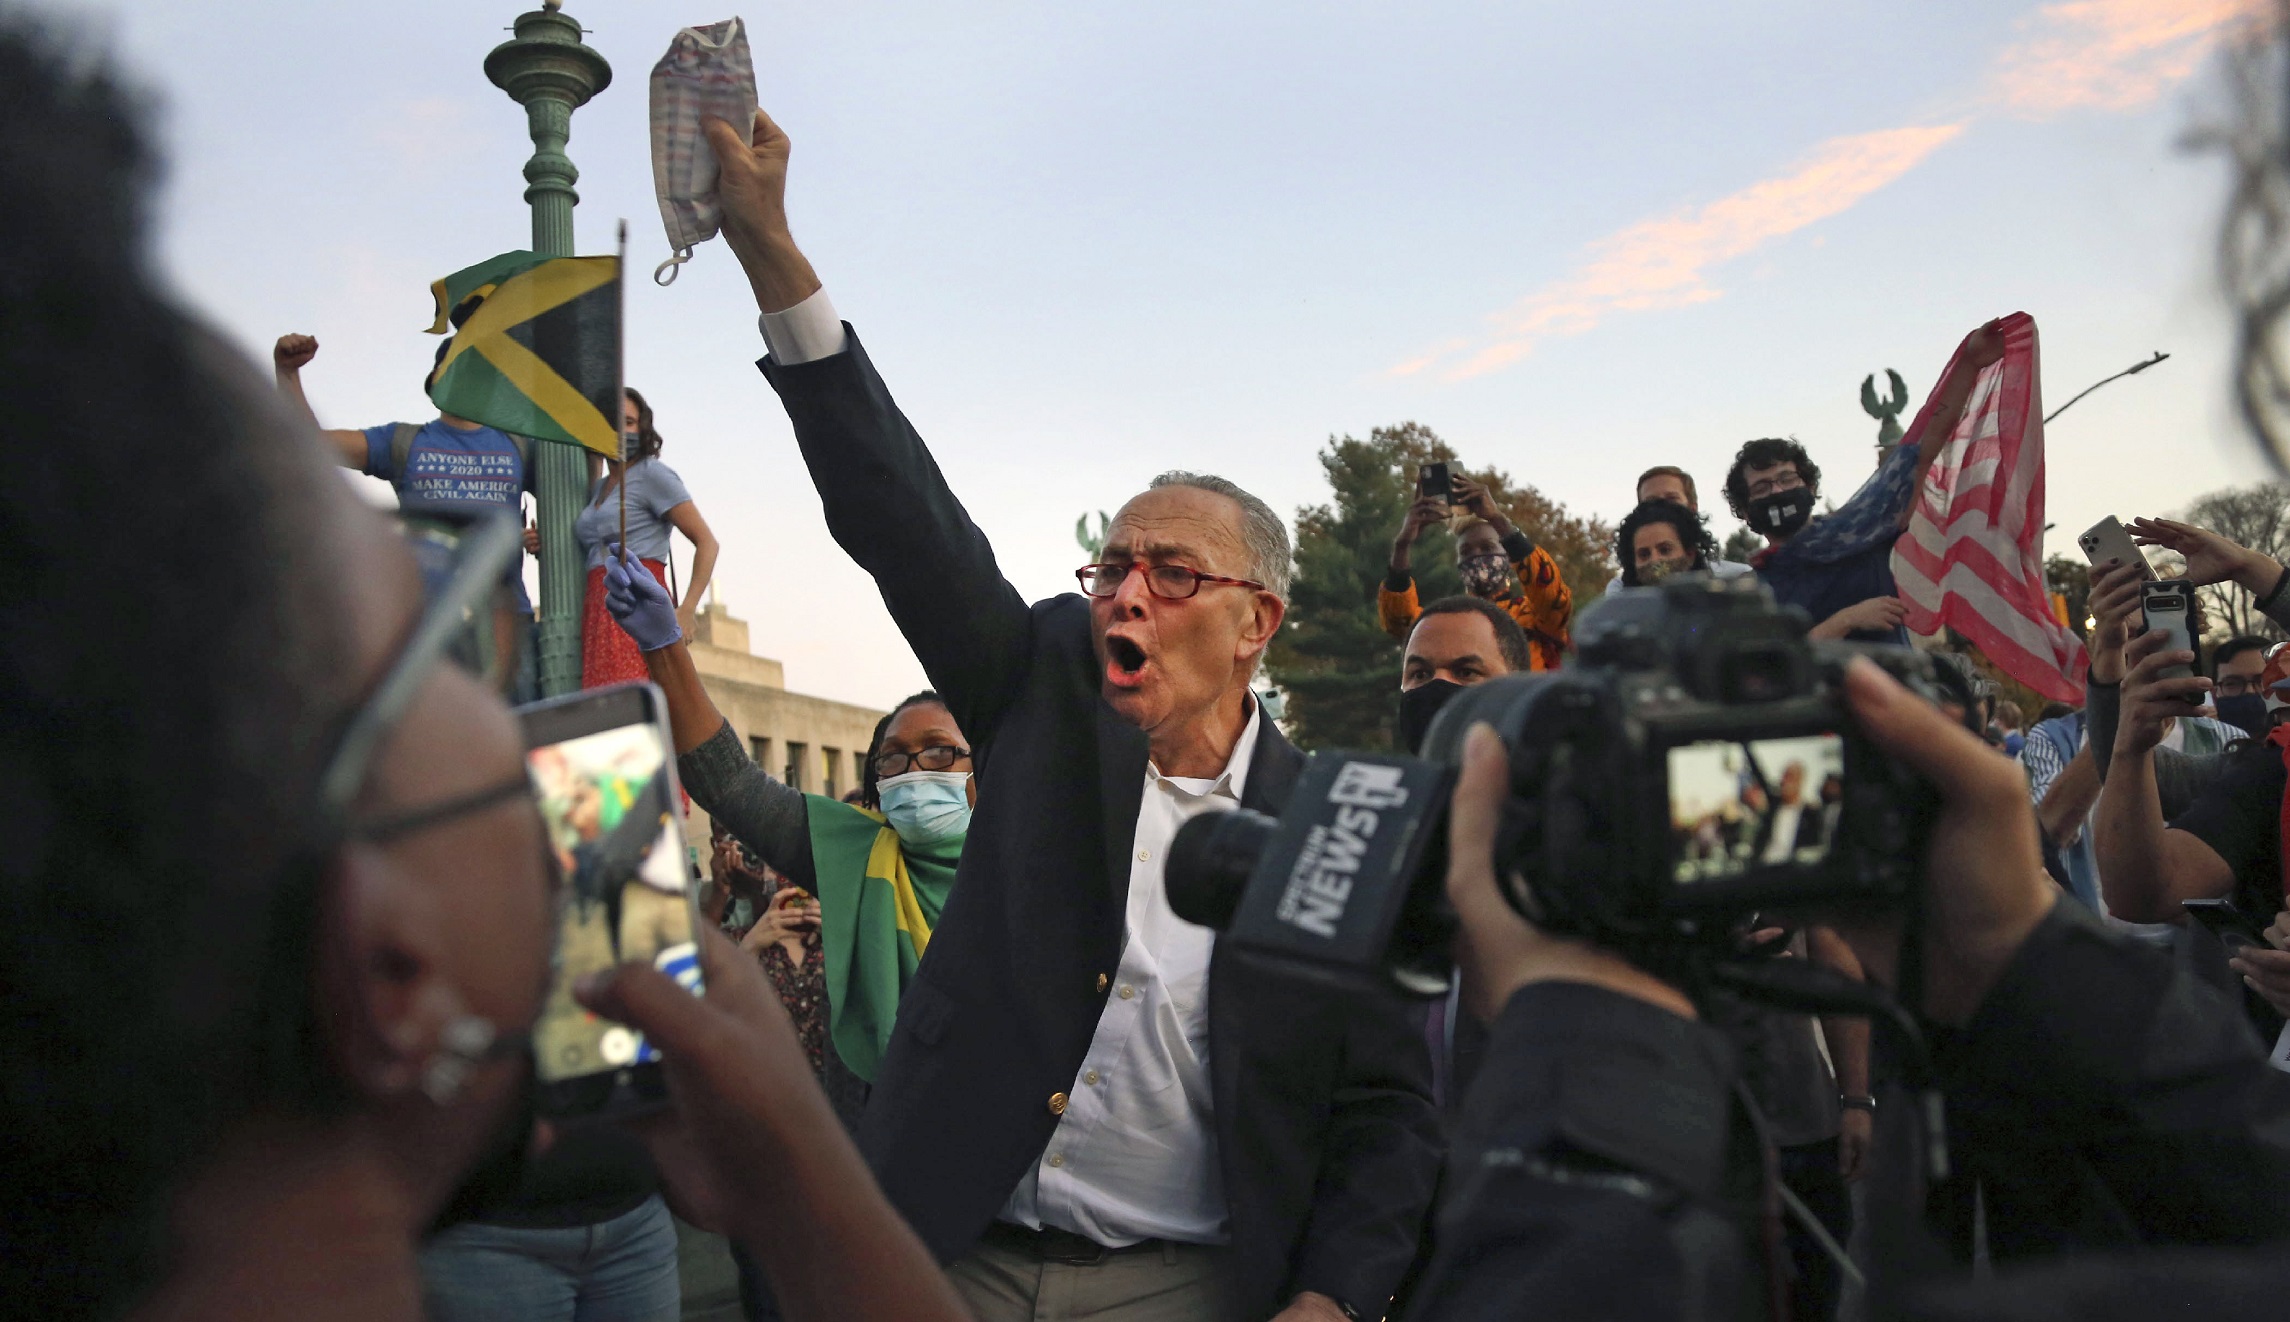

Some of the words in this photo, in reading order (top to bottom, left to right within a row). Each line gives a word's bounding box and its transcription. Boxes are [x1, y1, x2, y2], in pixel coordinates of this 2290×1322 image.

[417, 453, 476, 465] ANYONE
[482, 456, 513, 465] ELSE
[450, 465, 482, 475] 2020
[413, 479, 452, 490] MAKE
[458, 481, 517, 494] AMERICA
[424, 491, 461, 499] CIVIL
[466, 492, 507, 501] AGAIN
[1293, 806, 1379, 938] NEWS
